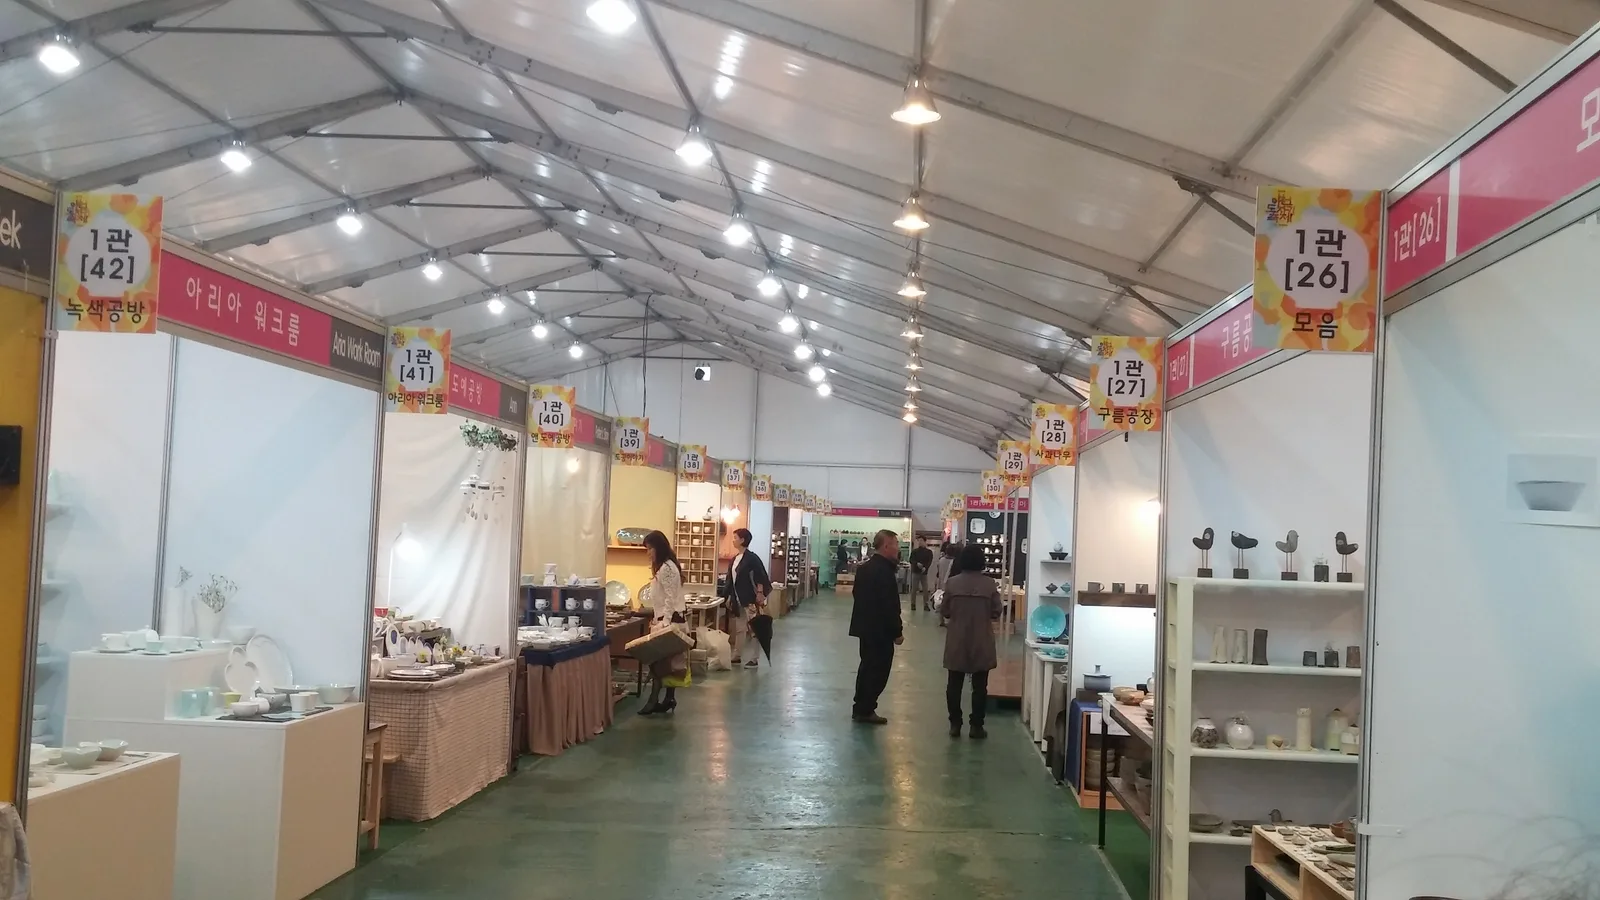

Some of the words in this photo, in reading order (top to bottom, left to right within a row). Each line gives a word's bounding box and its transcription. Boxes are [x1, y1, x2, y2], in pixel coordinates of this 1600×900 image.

[1576, 87, 1600, 153] 모
[0, 209, 21, 249] ek
[90, 229, 132, 253] 1관
[1296, 229, 1346, 258] 1관
[81, 254, 135, 284] [42]
[1285, 258, 1349, 293] [26]
[66, 298, 145, 324] 녹색공방
[186, 277, 242, 323] 아리아
[254, 301, 300, 347] 워크룸
[1292, 312, 1338, 339] 모음
[1221, 313, 1252, 359] 구름공
[332, 331, 346, 356] Aria
[347, 336, 364, 361] Work
[363, 342, 381, 369] Room
[405, 349, 432, 364] 1관
[400, 365, 434, 383] [41]
[1114, 360, 1143, 377] 1관
[452, 374, 482, 405] 도예공방
[1107, 377, 1145, 397] [27]
[387, 392, 415, 405] 아리아
[417, 393, 444, 408] 워크룸
[543, 401, 563, 413] 1관
[539, 413, 564, 426] [40]
[1046, 419, 1065, 431] 1관
[1098, 407, 1154, 425] 구름공장
[623, 429, 639, 438] 1관
[1041, 430, 1066, 444] [28]
[620, 438, 640, 448] [39]
[684, 461, 700, 470] [38]
[686, 453, 699, 461] 1관
[1004, 460, 1023, 470] [29]
[1007, 452, 1022, 461] 1관
